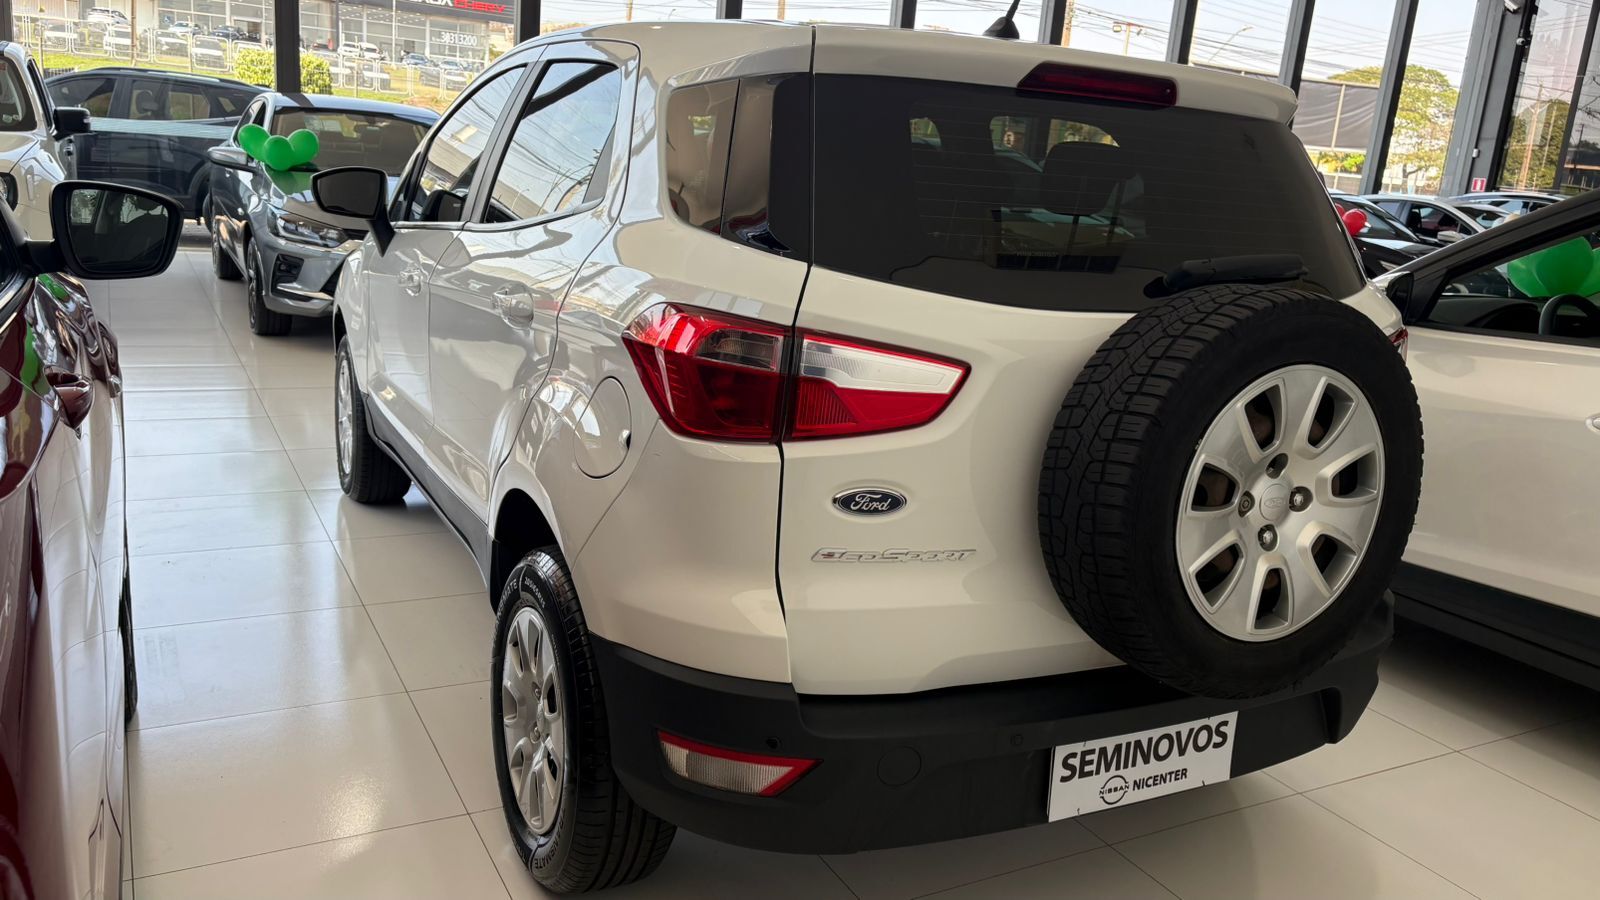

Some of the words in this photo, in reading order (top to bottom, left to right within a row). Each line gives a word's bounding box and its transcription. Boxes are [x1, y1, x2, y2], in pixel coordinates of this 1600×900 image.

[850, 493, 890, 511] Ford
[1059, 720, 1229, 783] SEMINOVOS
[1099, 780, 1129, 796] NISSAN
[1132, 768, 1188, 791] NICENTER
